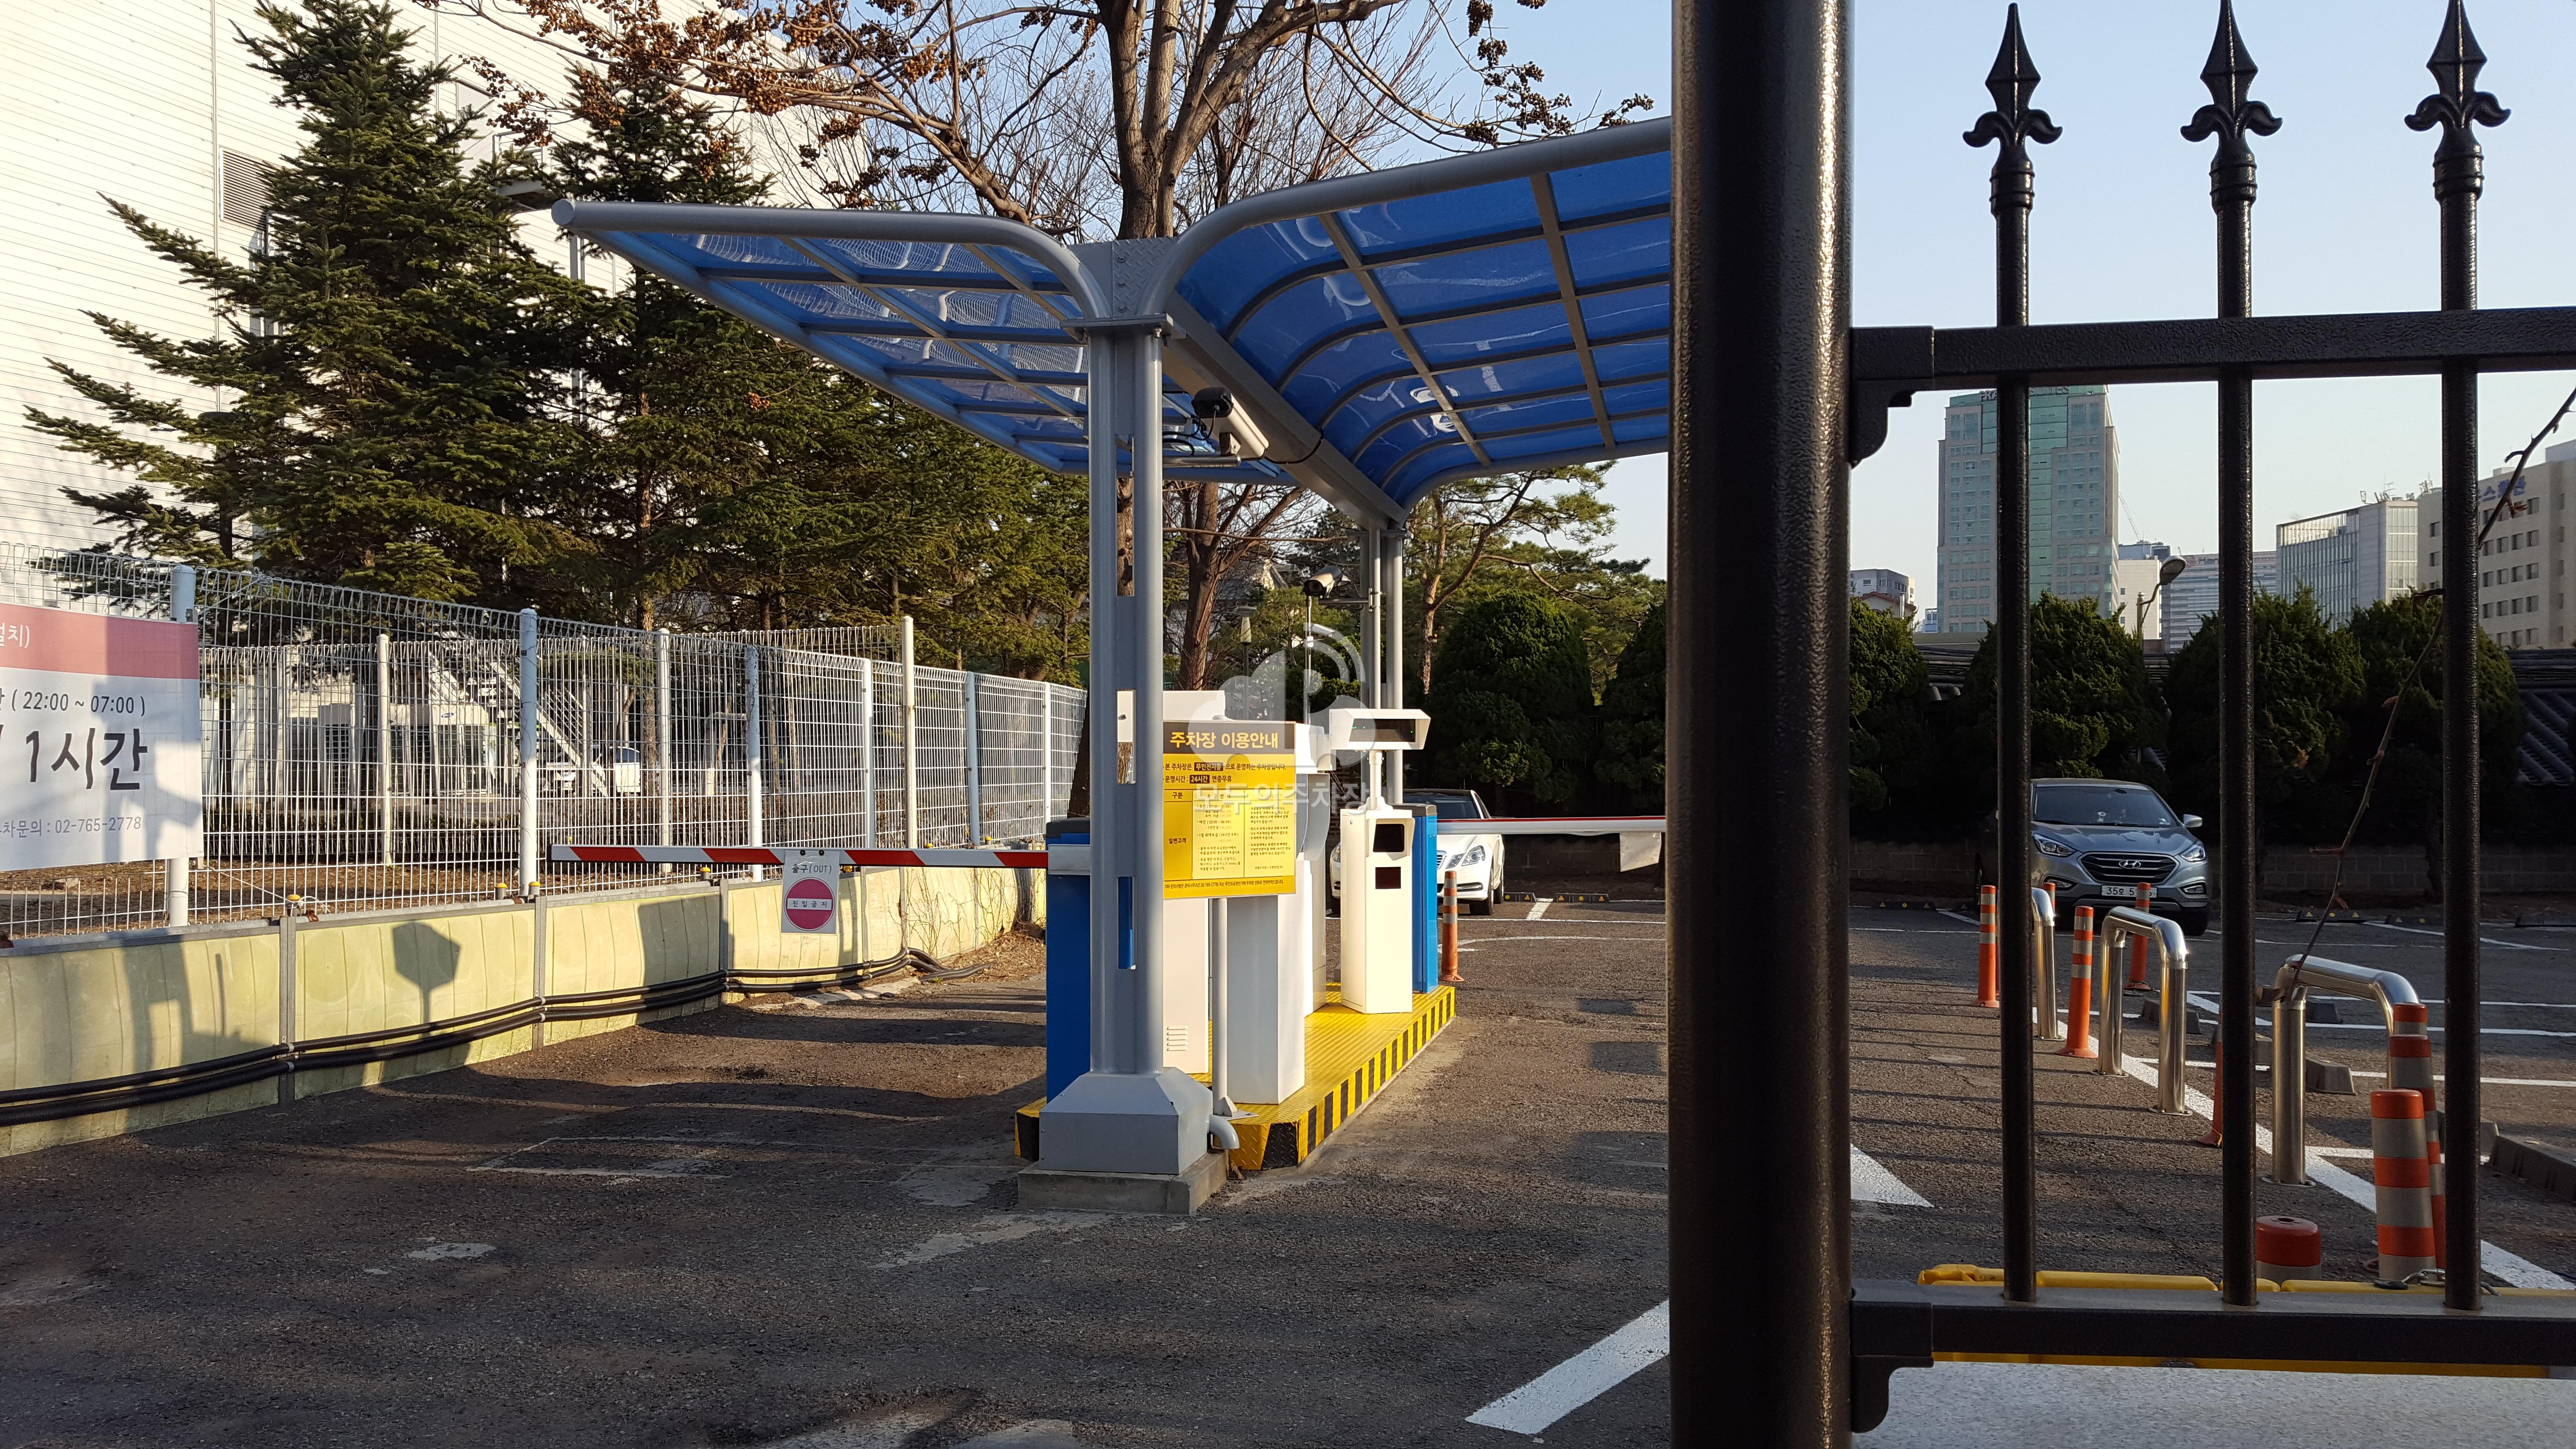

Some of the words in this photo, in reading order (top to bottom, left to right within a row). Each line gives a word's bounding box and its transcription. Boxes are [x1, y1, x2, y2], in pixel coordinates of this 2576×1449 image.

[1170, 732, 1216, 749] 주차장
[1221, 732, 1278, 749] 이용안내
[26, 727, 147, 790] 1시간
[0, 819, 42, 838] 차문의
[55, 816, 142, 834] 02-765-2778
